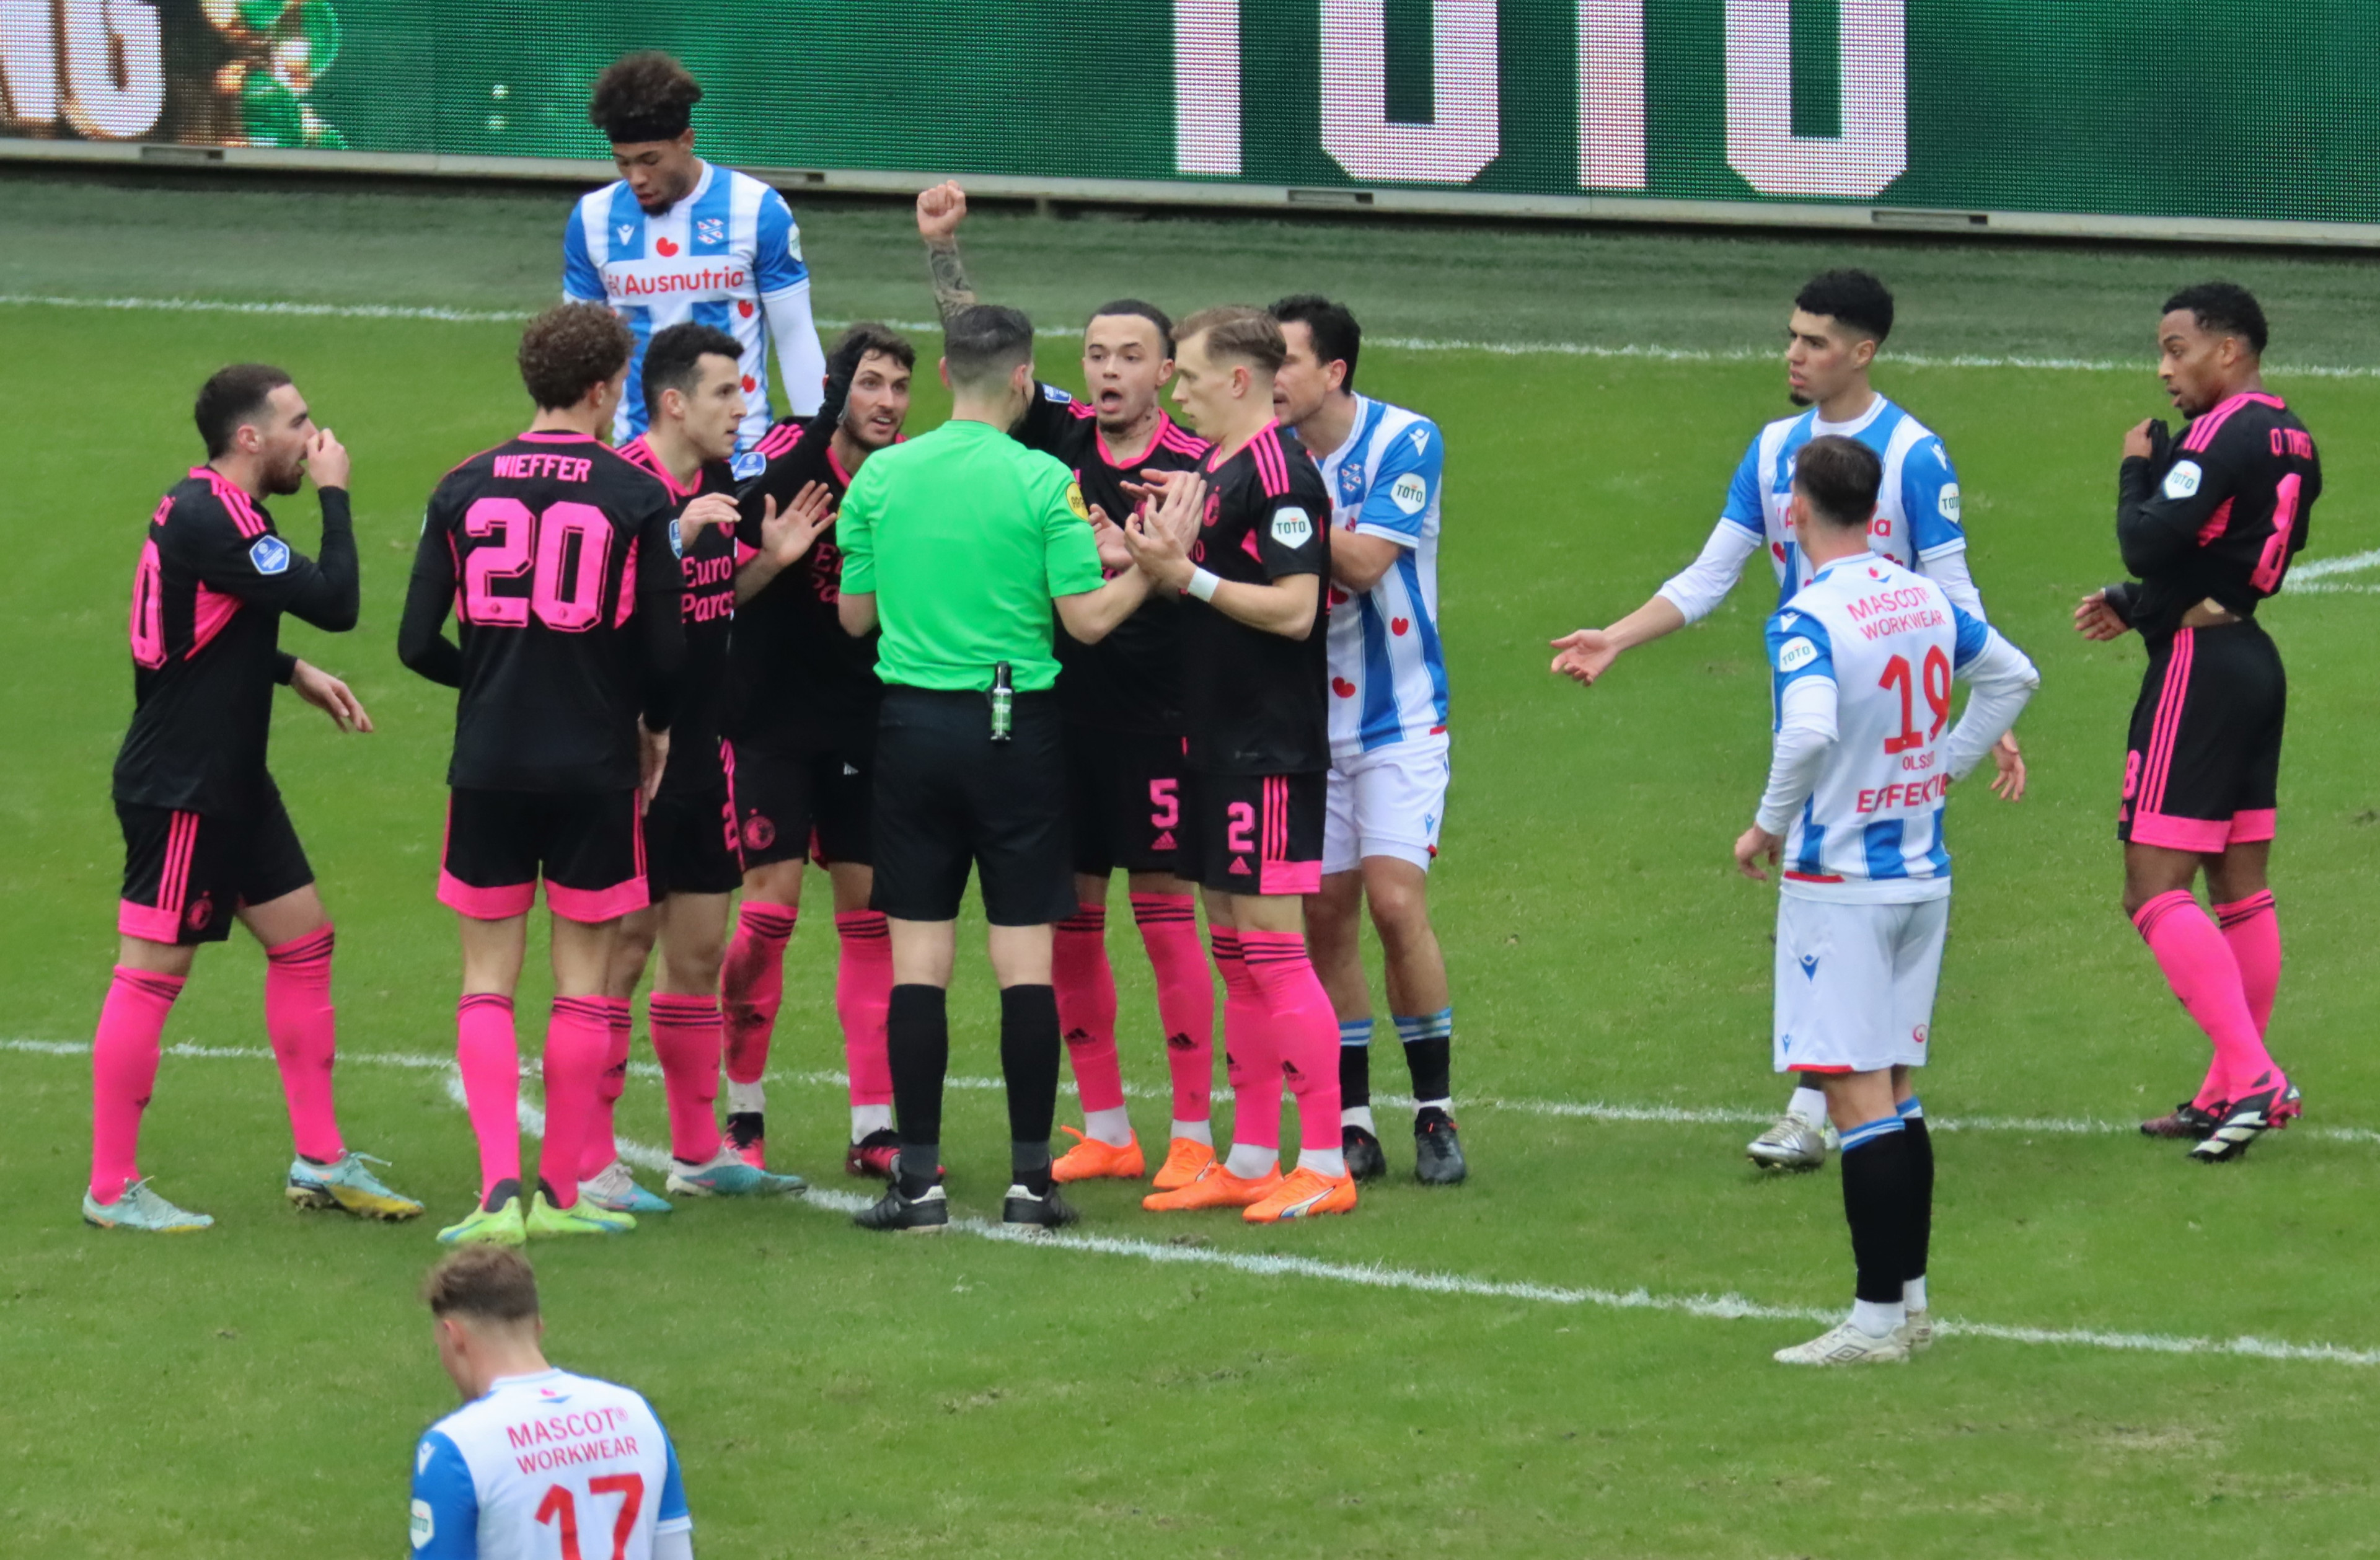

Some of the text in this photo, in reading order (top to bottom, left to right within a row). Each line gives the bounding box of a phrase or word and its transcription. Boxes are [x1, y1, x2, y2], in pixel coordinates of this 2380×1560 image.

[493, 454, 593, 483] WIEFFER
[1396, 484, 1423, 503] TOTO
[1276, 521, 1306, 535] TOTO
[465, 497, 614, 633] 20
[681, 555, 732, 588] Euro
[1859, 609, 1946, 641] WORKWEAR
[1783, 646, 1810, 666] TOTO
[1878, 644, 1950, 754] 19
[1150, 778, 1179, 829] 5
[1228, 801, 1255, 853] 2
[516, 1436, 639, 1475] WORKWEAR
[534, 1473, 645, 1560] 17
